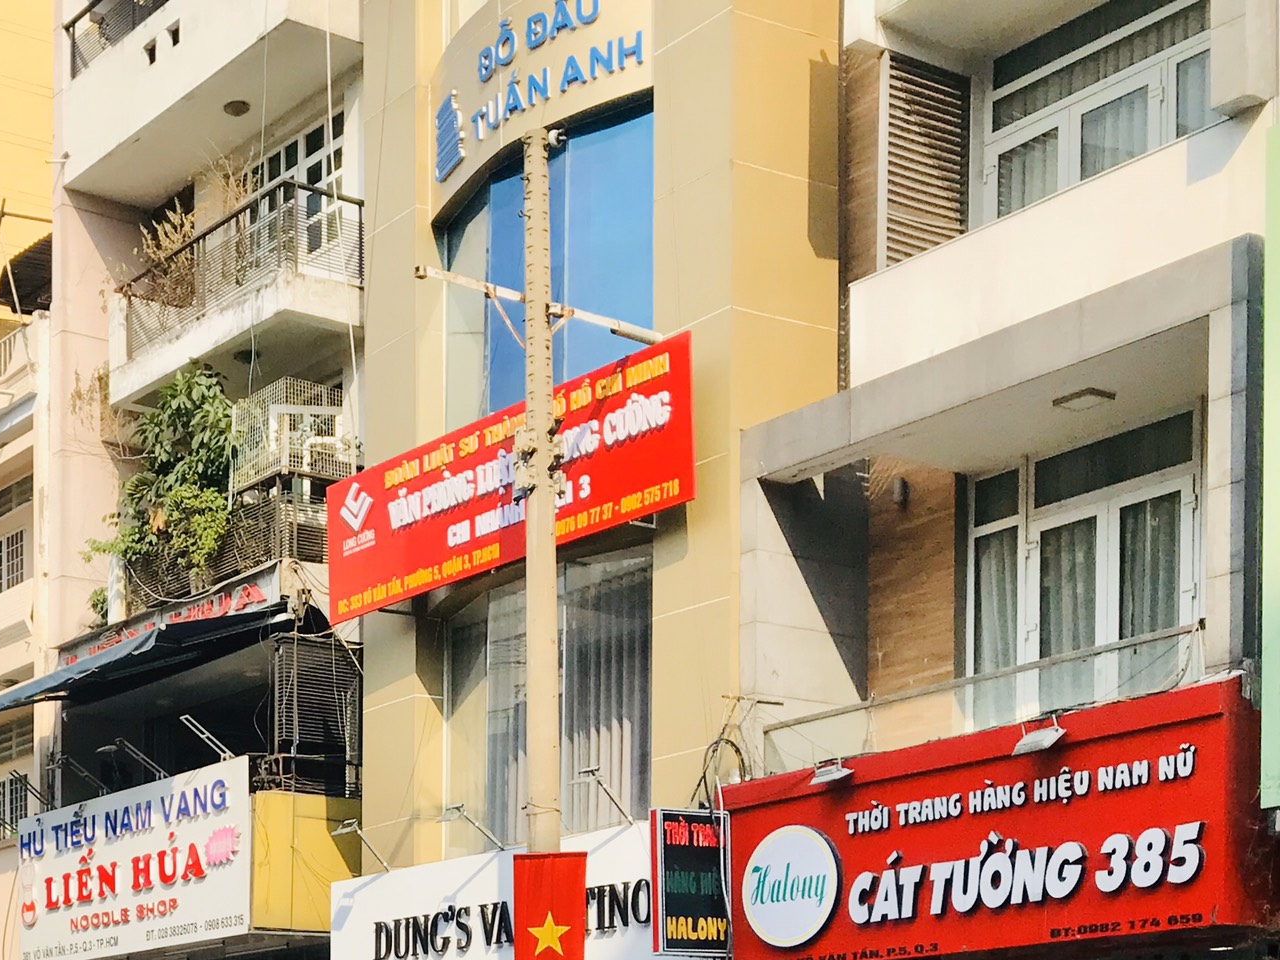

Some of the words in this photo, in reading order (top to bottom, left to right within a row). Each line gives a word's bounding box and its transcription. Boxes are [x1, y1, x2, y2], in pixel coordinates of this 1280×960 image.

[560, 30, 642, 93] ANH
[384, 459, 419, 490] ĐOÀN
[423, 443, 455, 473] LUẬT
[459, 431, 480, 458] SƯ
[626, 352, 669, 388] MINH
[421, 469, 475, 517] PHÒNG
[603, 390, 671, 446] CƯỜNG
[447, 519, 470, 548] CHI
[579, 474, 591, 499] 3
[590, 506, 600, 524] 77
[602, 502, 613, 520] 37
[644, 485, 661, 505] 575
[662, 478, 680, 498] 718
[20, 818, 44, 859] HỦ
[51, 803, 97, 851] TIẾU
[105, 800, 152, 839] NAM
[161, 779, 227, 823] VANG
[845, 800, 889, 835] THỜI
[896, 793, 962, 826] TRANG
[968, 779, 1026, 814] HÀNG
[1033, 766, 1090, 804] HIỆU
[1097, 759, 1150, 792] NAM
[1158, 742, 1196, 781] NỮ
[45, 848, 117, 910] LIẾN
[131, 831, 206, 892] HÚA
[700, 866, 720, 899] HIỆ
[749, 862, 828, 908] Halony
[847, 849, 923, 924] CÁT
[928, 830, 1086, 916] TƯỜNG
[1094, 820, 1204, 893] 385
[70, 907, 130, 932] NOODLE
[136, 898, 178, 920] SHOP
[158, 927, 168, 939] 028
[204, 918, 220, 931] 0908
[221, 916, 232, 929] 633
[666, 916, 727, 941] HALONY
[1128, 917, 1161, 930] 174
